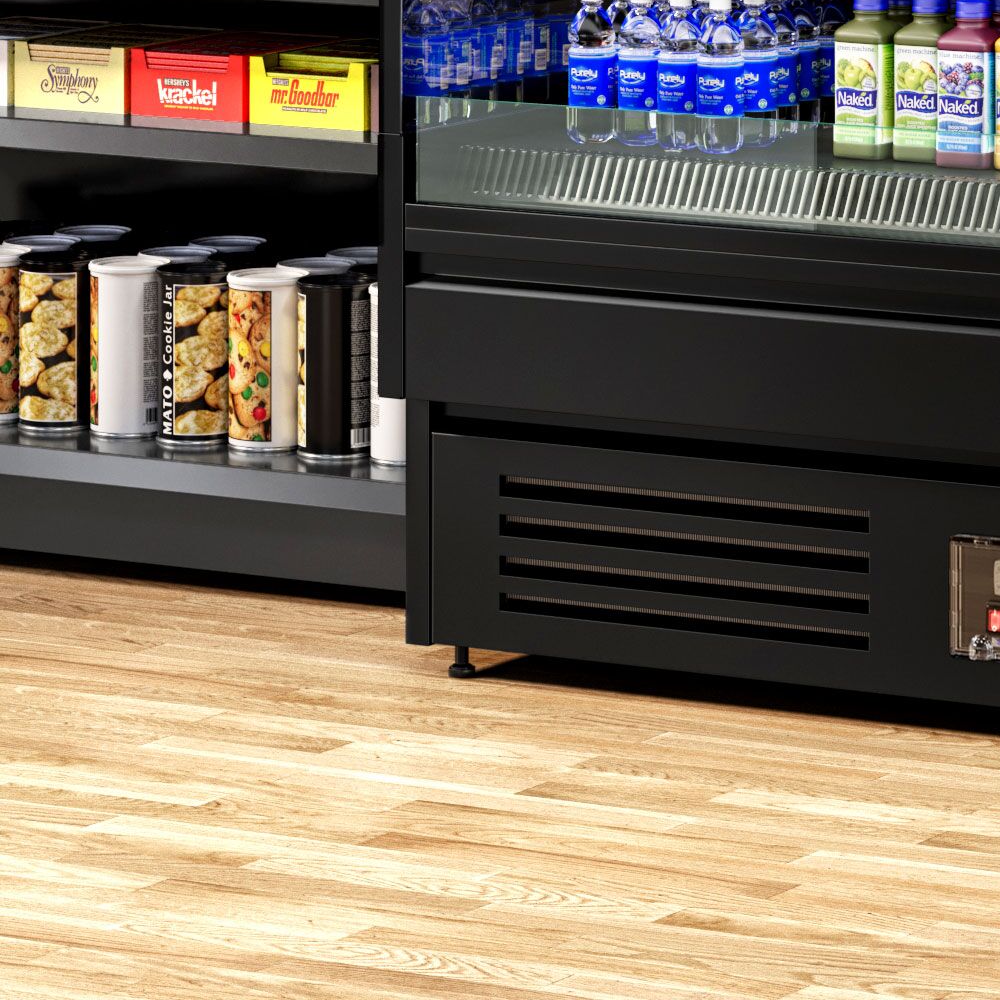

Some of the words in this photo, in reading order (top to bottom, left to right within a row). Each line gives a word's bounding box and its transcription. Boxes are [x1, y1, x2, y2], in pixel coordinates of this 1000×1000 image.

[897, 48, 911, 56] green
[571, 67, 597, 80] Purely
[620, 69, 646, 82] Purely
[659, 73, 685, 86] Purely
[41, 64, 99, 104] Symphony
[699, 76, 725, 89] Purely
[158, 79, 217, 106] krackel
[271, 88, 287, 104] mr.
[288, 79, 339, 107] Goodbar
[837, 91, 874, 107] Naked
[898, 94, 935, 110] Naked
[939, 99, 979, 115] Naked
[163, 284, 173, 318] Jar
[163, 320, 173, 364] Cookie
[163, 385, 174, 434] MATO
